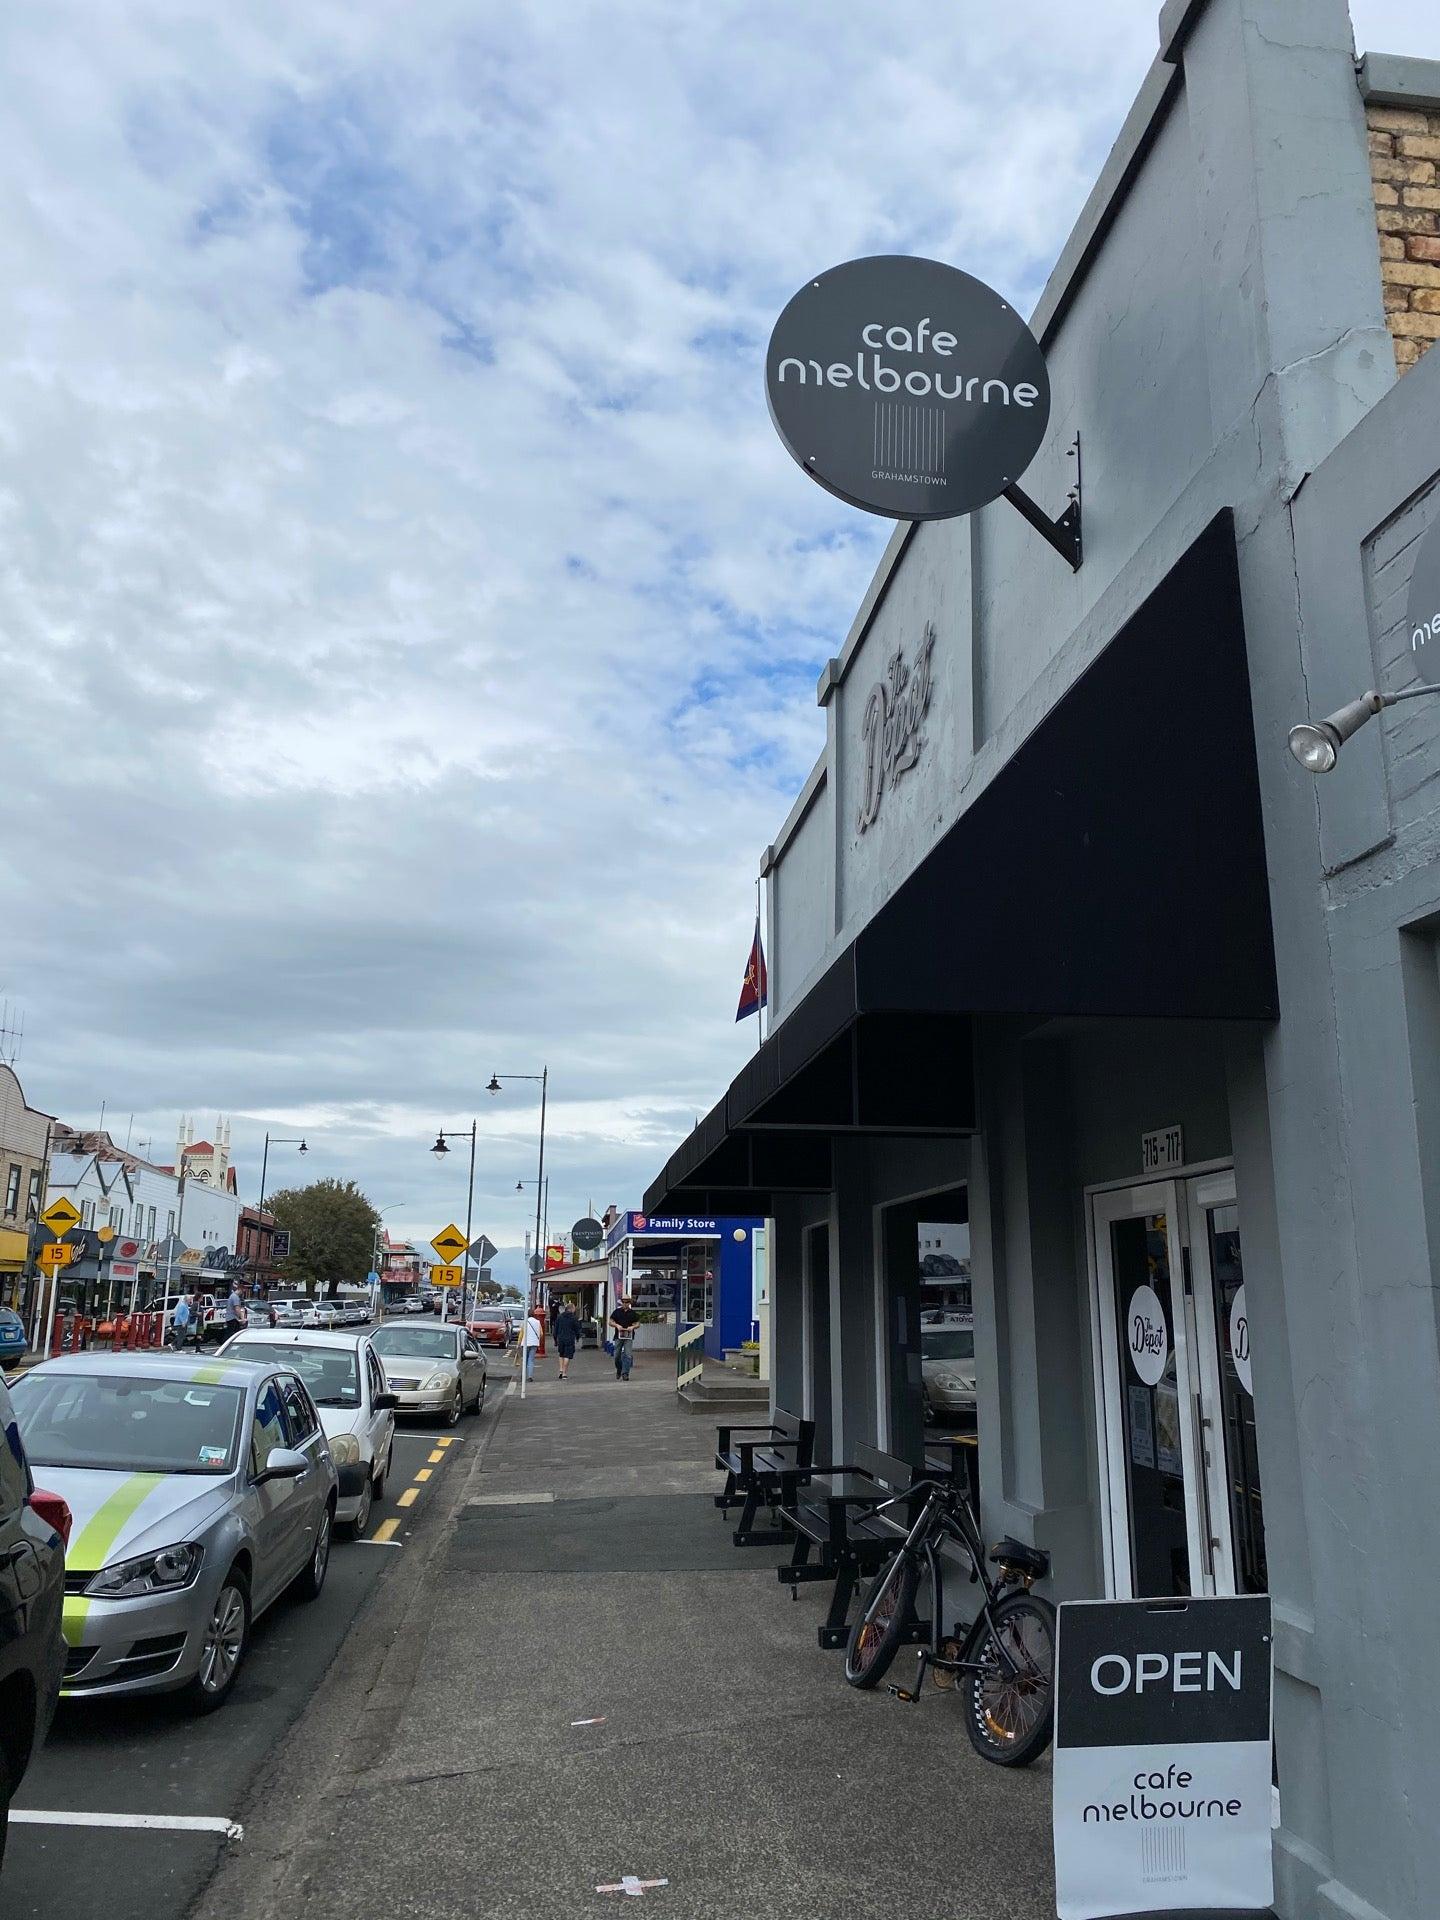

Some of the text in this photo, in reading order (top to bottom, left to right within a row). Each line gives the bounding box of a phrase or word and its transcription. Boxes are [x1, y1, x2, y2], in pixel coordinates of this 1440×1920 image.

[862, 318, 958, 355] cafe
[778, 352, 1039, 407] melbourne
[871, 470, 947, 486] GRAHAMSTOWN
[649, 1218, 716, 1230] Family Store
[50, 1248, 63, 1260] 15
[439, 1270, 454, 1281] 15
[1132, 1315, 1164, 1356] Depot
[1090, 1650, 1243, 1696] OPEN
[1133, 1763, 1193, 1790] cafe
[1083, 1794, 1242, 1823] melbourne
